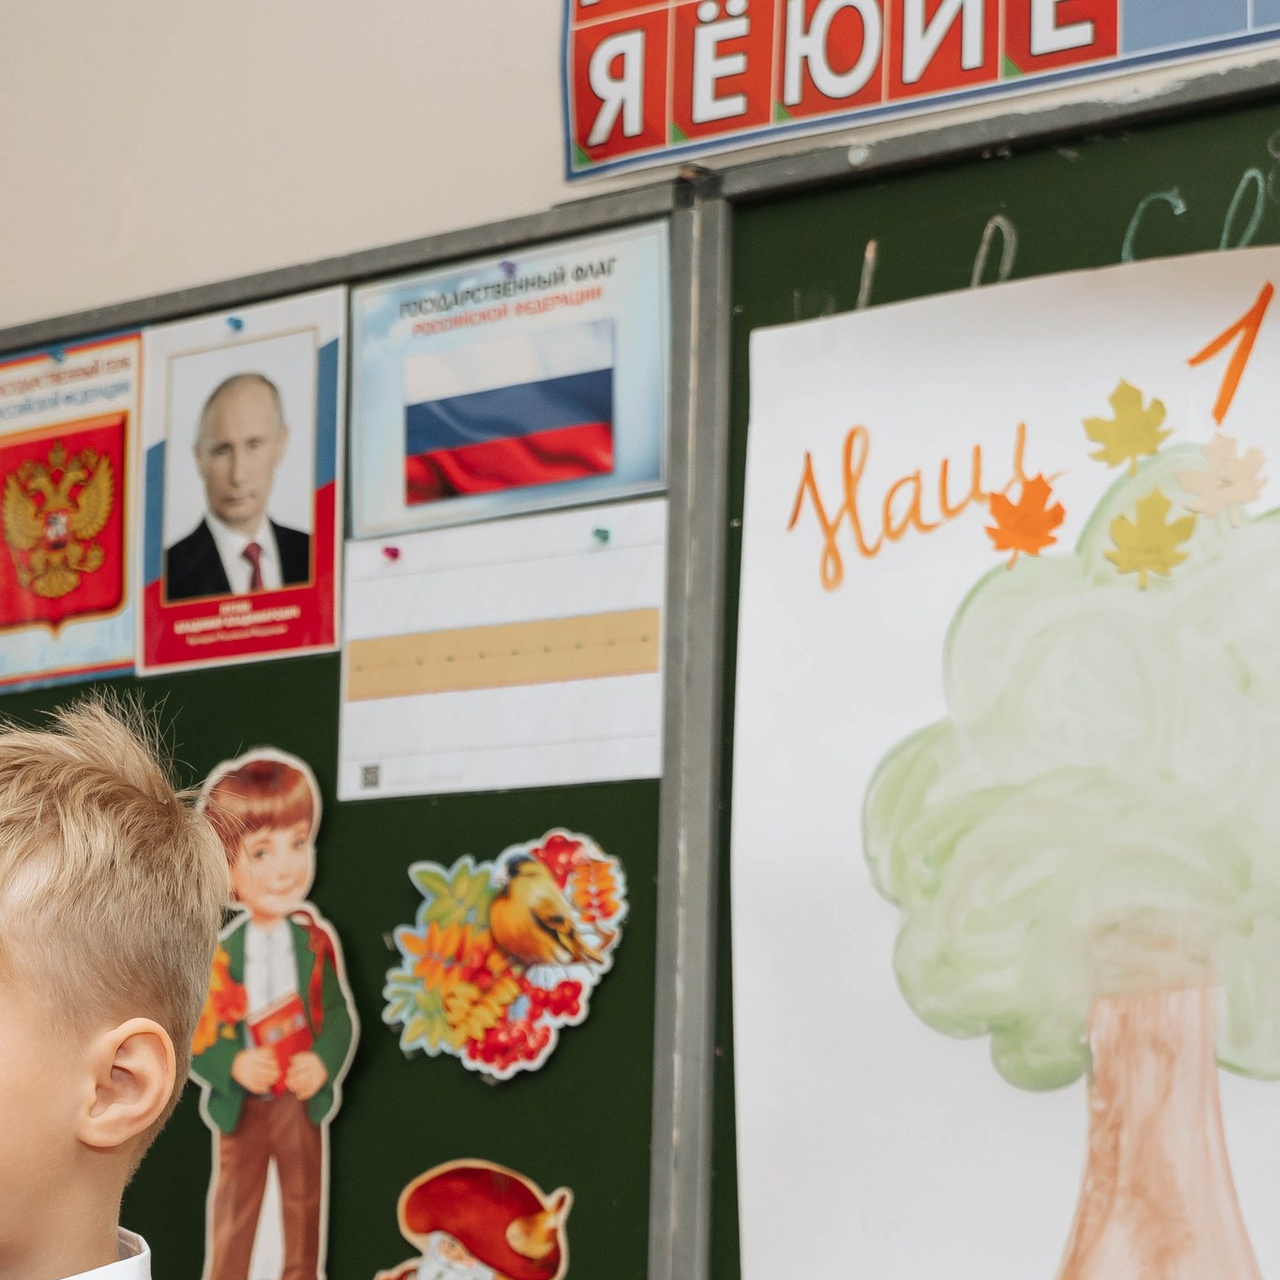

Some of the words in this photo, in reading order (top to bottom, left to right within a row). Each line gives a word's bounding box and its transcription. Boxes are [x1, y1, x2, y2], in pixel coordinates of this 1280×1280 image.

[587, 29, 644, 146] Я
[692, 0, 748, 123] Ё
[783, 0, 883, 106] Ю
[1186, 279, 1275, 426] 1
